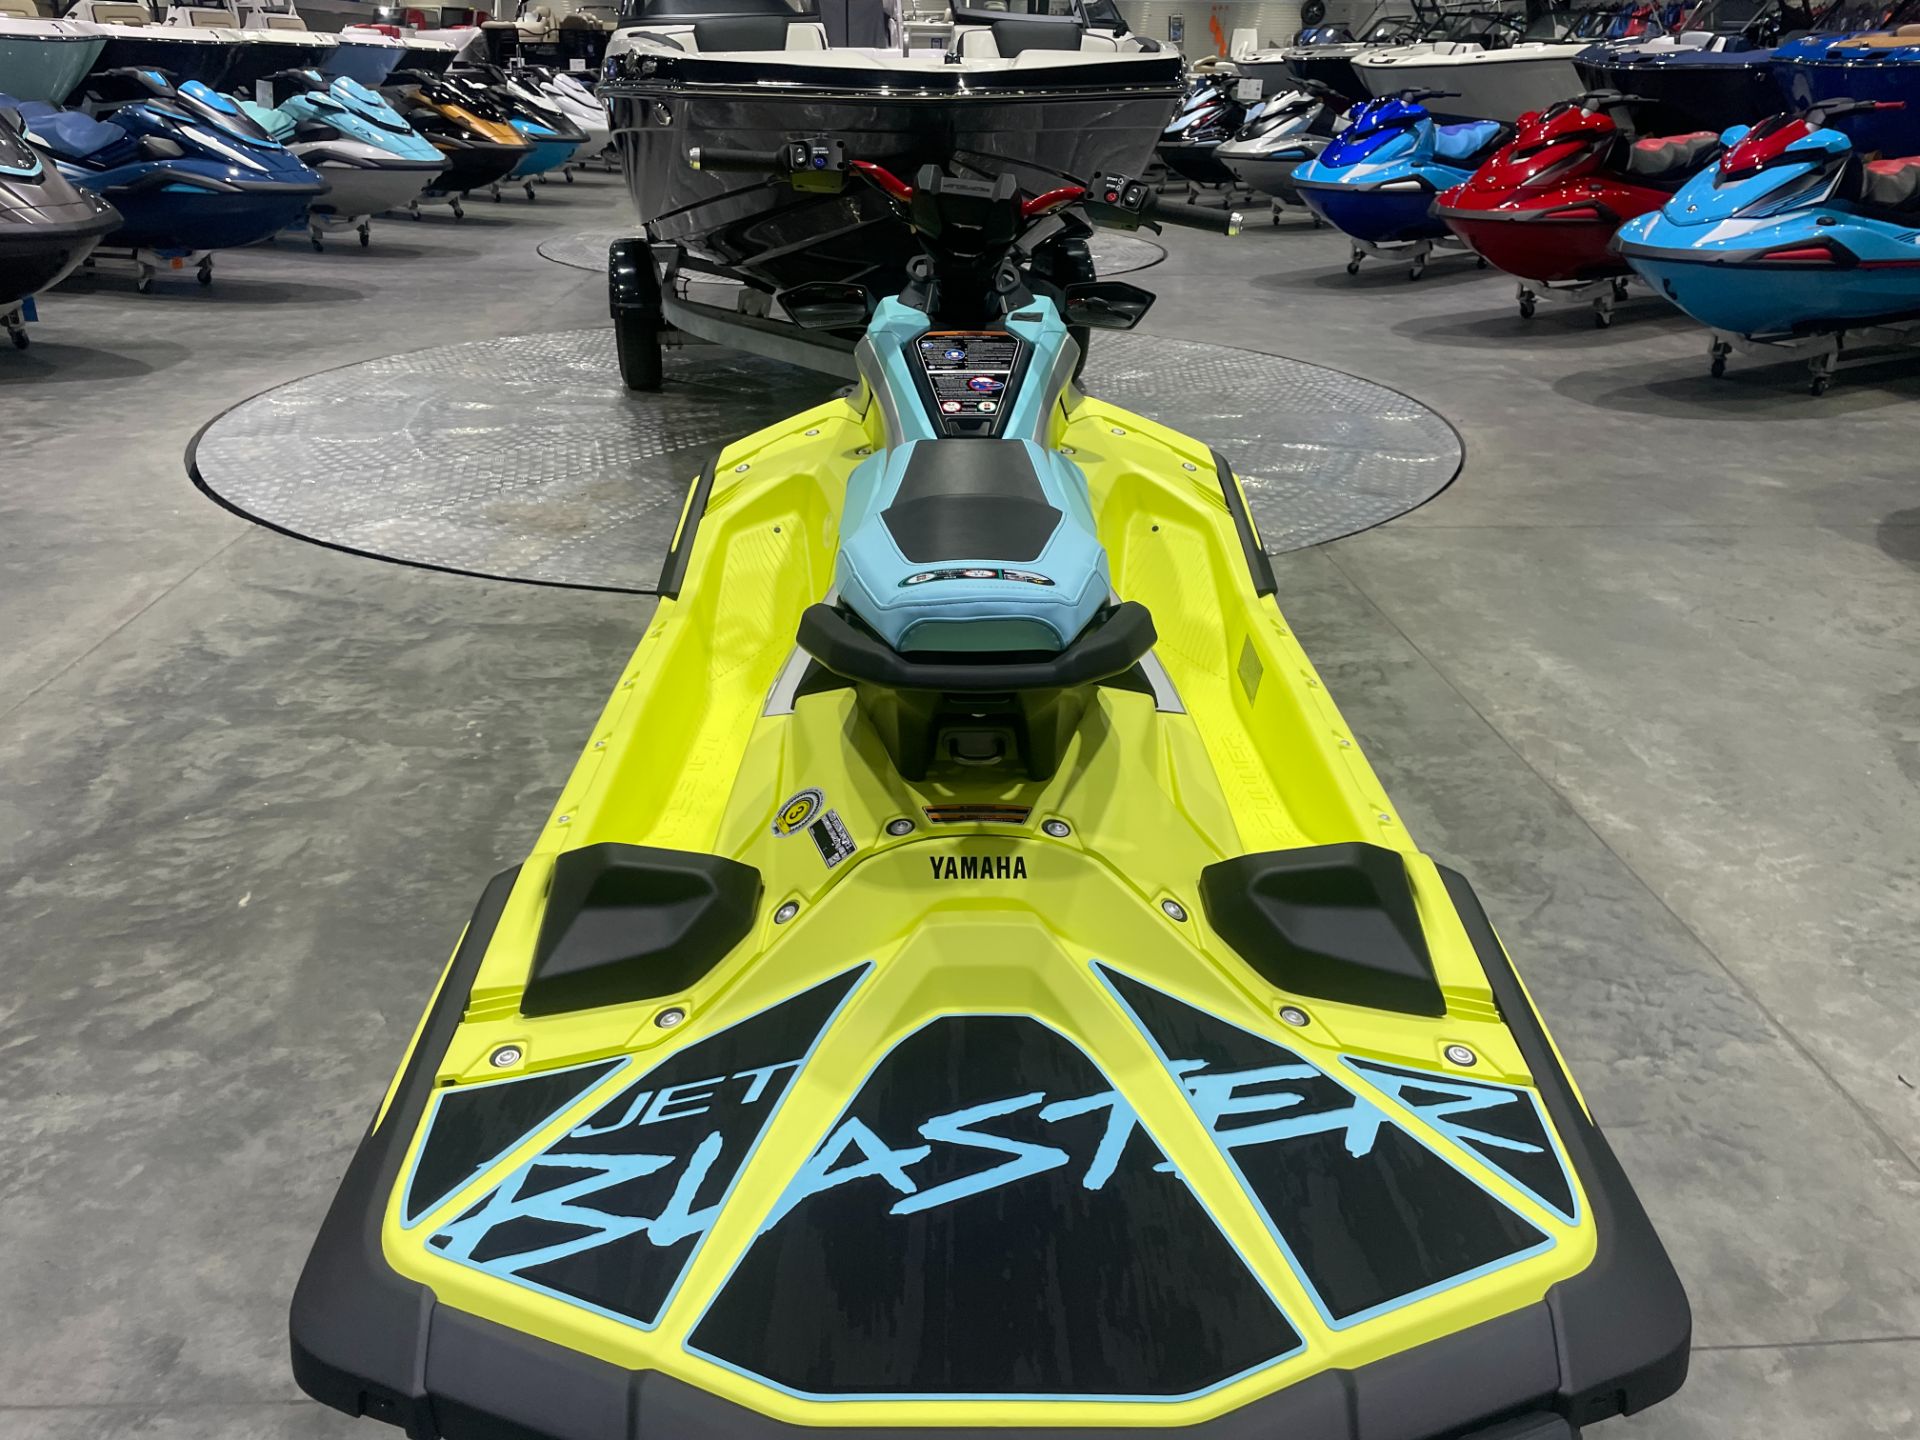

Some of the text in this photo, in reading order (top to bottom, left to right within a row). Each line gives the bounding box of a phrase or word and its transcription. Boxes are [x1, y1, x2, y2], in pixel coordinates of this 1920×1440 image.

[930, 856, 1028, 880] YAMAHA
[570, 1058, 804, 1138] JET
[430, 1058, 1546, 1274] BLASTER
